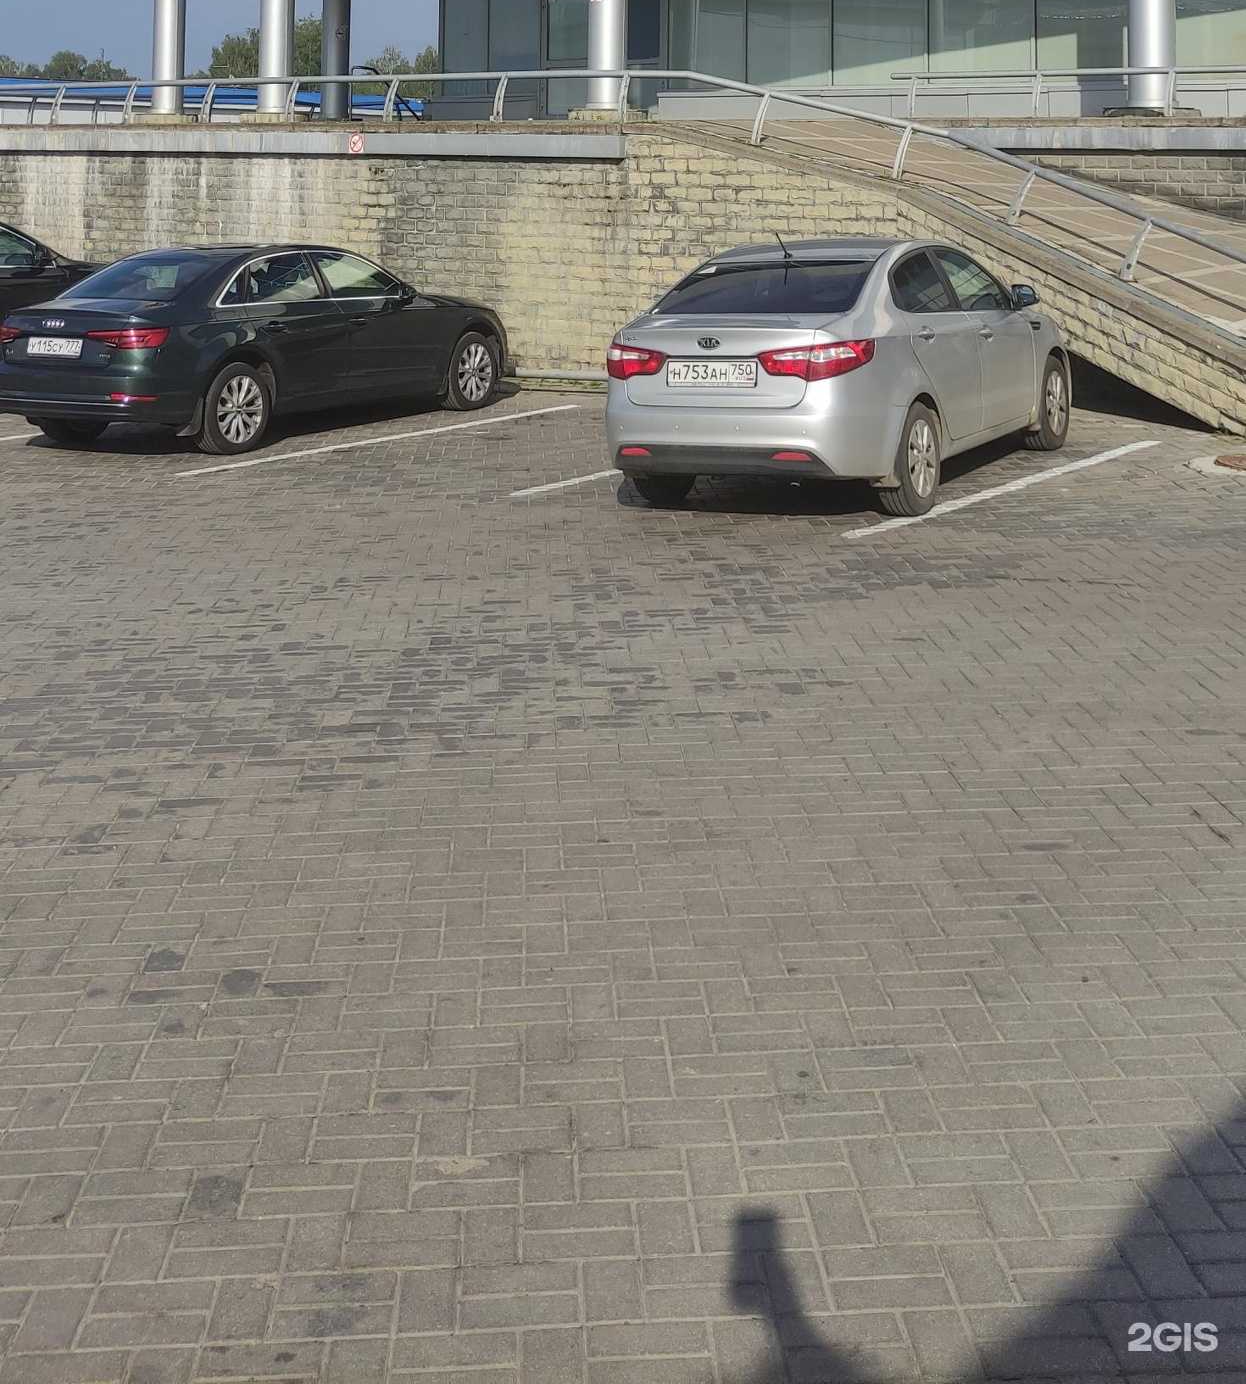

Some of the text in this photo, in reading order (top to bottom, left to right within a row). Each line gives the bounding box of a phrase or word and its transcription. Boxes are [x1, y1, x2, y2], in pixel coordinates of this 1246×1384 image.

[699, 336, 720, 349] KIA
[672, 364, 752, 381] Н753АН 750
